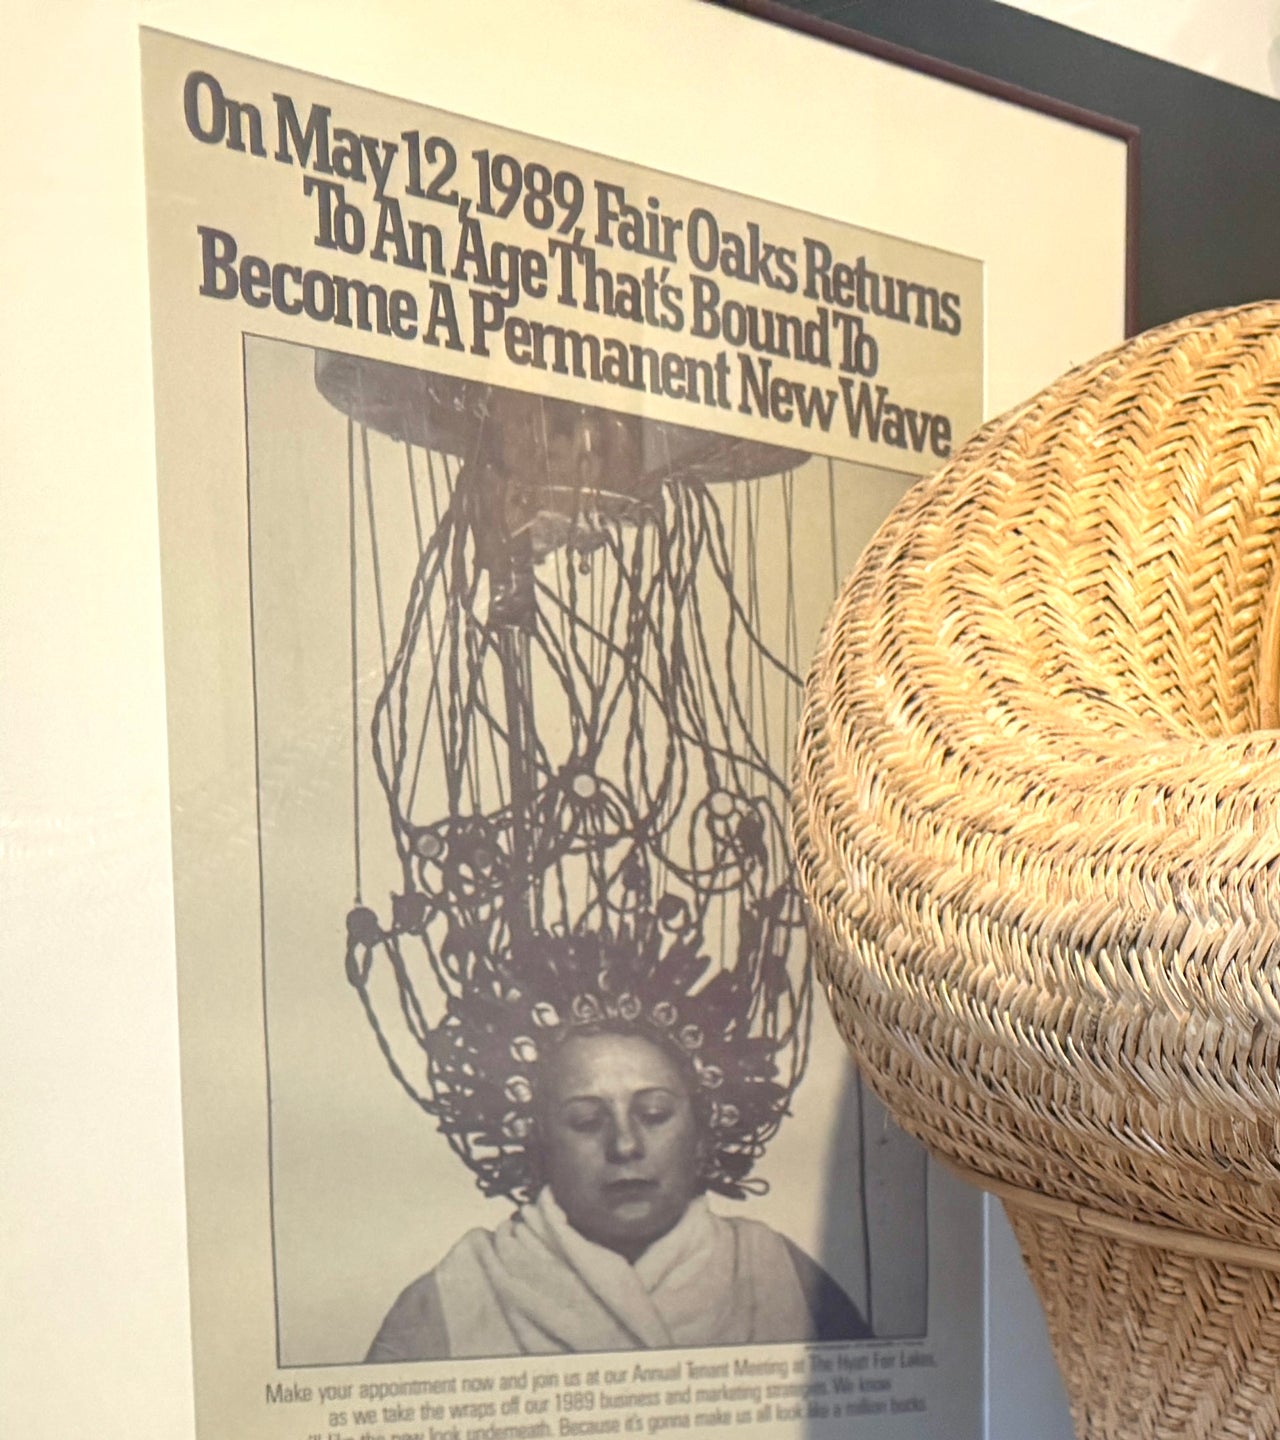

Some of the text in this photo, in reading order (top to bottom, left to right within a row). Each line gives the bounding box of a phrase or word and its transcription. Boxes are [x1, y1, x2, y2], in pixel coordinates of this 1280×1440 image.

[184, 70, 267, 158] On
[272, 92, 399, 202] May
[594, 180, 683, 263] Fair
[687, 207, 799, 294] Oaks
[803, 237, 962, 336] Returns
[303, 175, 879, 378] To An Age That's Bound To
[197, 225, 952, 458] Become A Permanent New Wave
[265, 1383, 313, 1404] Make
[317, 1386, 353, 1405] your
[359, 1377, 457, 1401] appointment
[461, 1378, 494, 1393] now
[499, 1372, 528, 1391] and
[532, 1371, 559, 1393] join
[563, 1373, 581, 1387] us
[585, 1370, 601, 1386] at
[603, 1368, 628, 1385] our
[632, 1362, 682, 1383] Annual
[733, 1359, 789, 1380] Meeting
[328, 1411, 349, 1427] as
[352, 1410, 378, 1426] we
[382, 1404, 416, 1424] take
[420, 1402, 445, 1421] the
[449, 1400, 497, 1420] wraps
[500, 1396, 521, 1416] off
[525, 1397, 550, 1414] our
[554, 1391, 595, 1412] 1989
[665, 1385, 692, 1406] and
[694, 1408, 732, 1427] make
